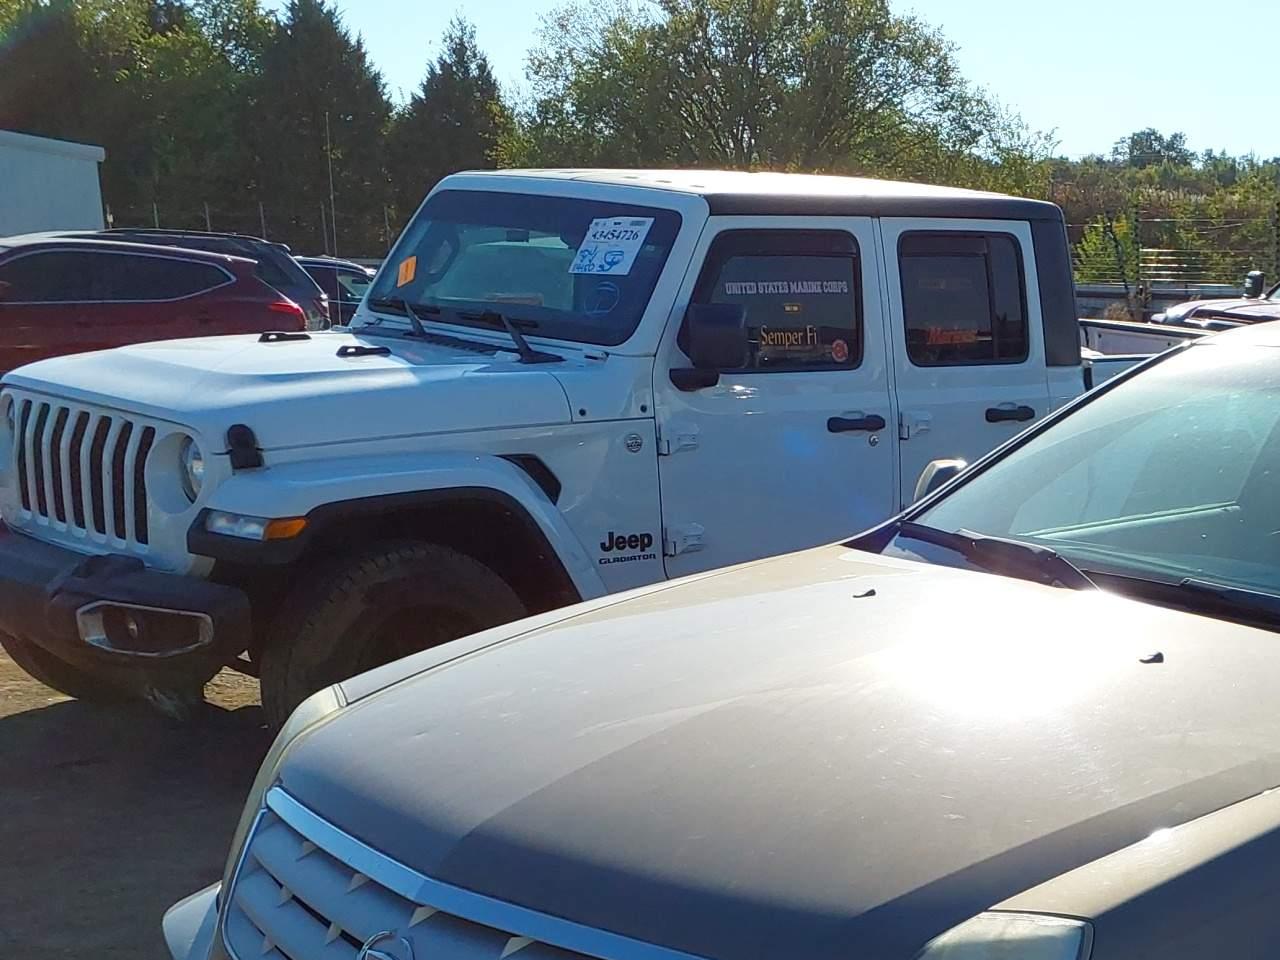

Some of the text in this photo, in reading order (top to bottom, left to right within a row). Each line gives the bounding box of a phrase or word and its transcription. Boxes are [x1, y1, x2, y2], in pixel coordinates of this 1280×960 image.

[592, 229, 640, 241] 43454726
[725, 281, 848, 295] UNITED STATES MARINE CORPS
[760, 324, 818, 350] Semper Fi
[600, 531, 653, 552] Jeep
[599, 553, 657, 565] GLADIATOR
